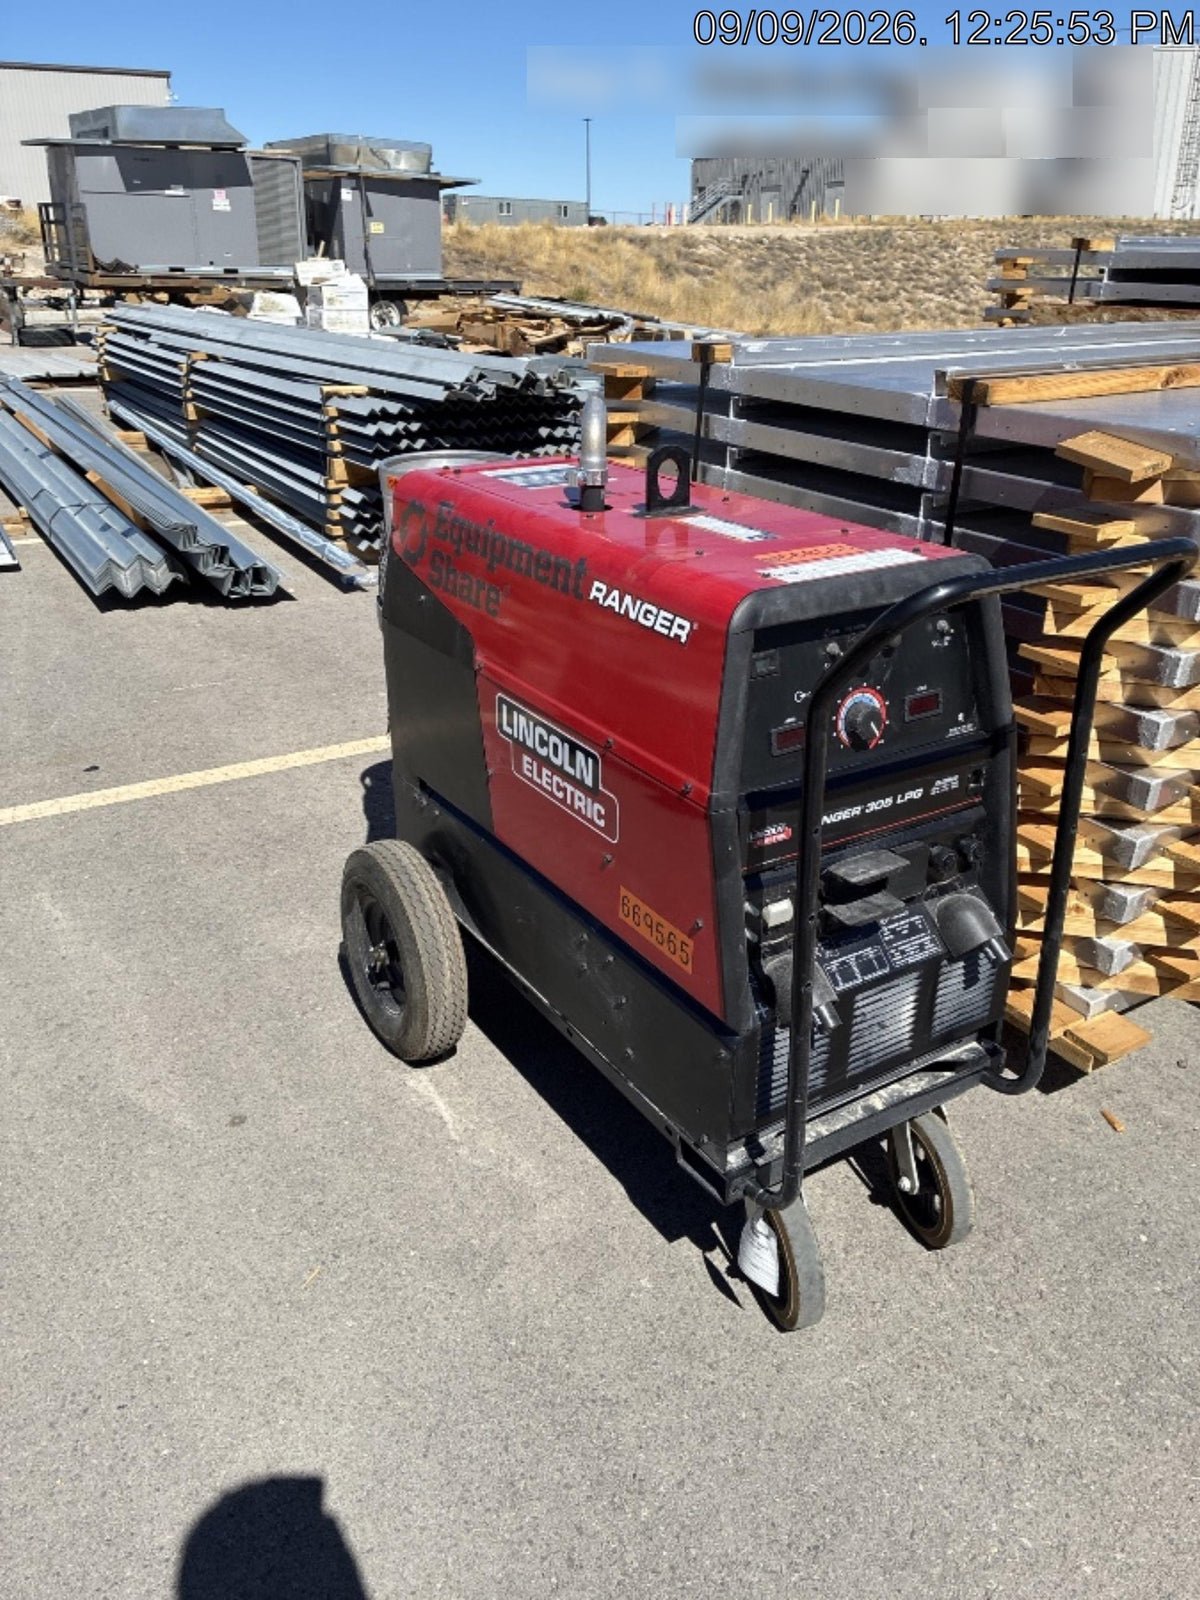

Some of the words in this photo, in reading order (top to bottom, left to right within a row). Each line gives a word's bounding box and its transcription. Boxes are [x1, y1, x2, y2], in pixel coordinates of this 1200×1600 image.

[428, 549, 500, 618] Share
[433, 501, 588, 599] Equipment
[589, 580, 692, 645] RANGER
[501, 703, 594, 788] LINCOLN
[522, 753, 606, 828] ELECTRIC
[820, 805, 862, 826] NGER
[864, 795, 894, 814] 305
[896, 787, 924, 805] LPG
[621, 895, 690, 966] 669565
